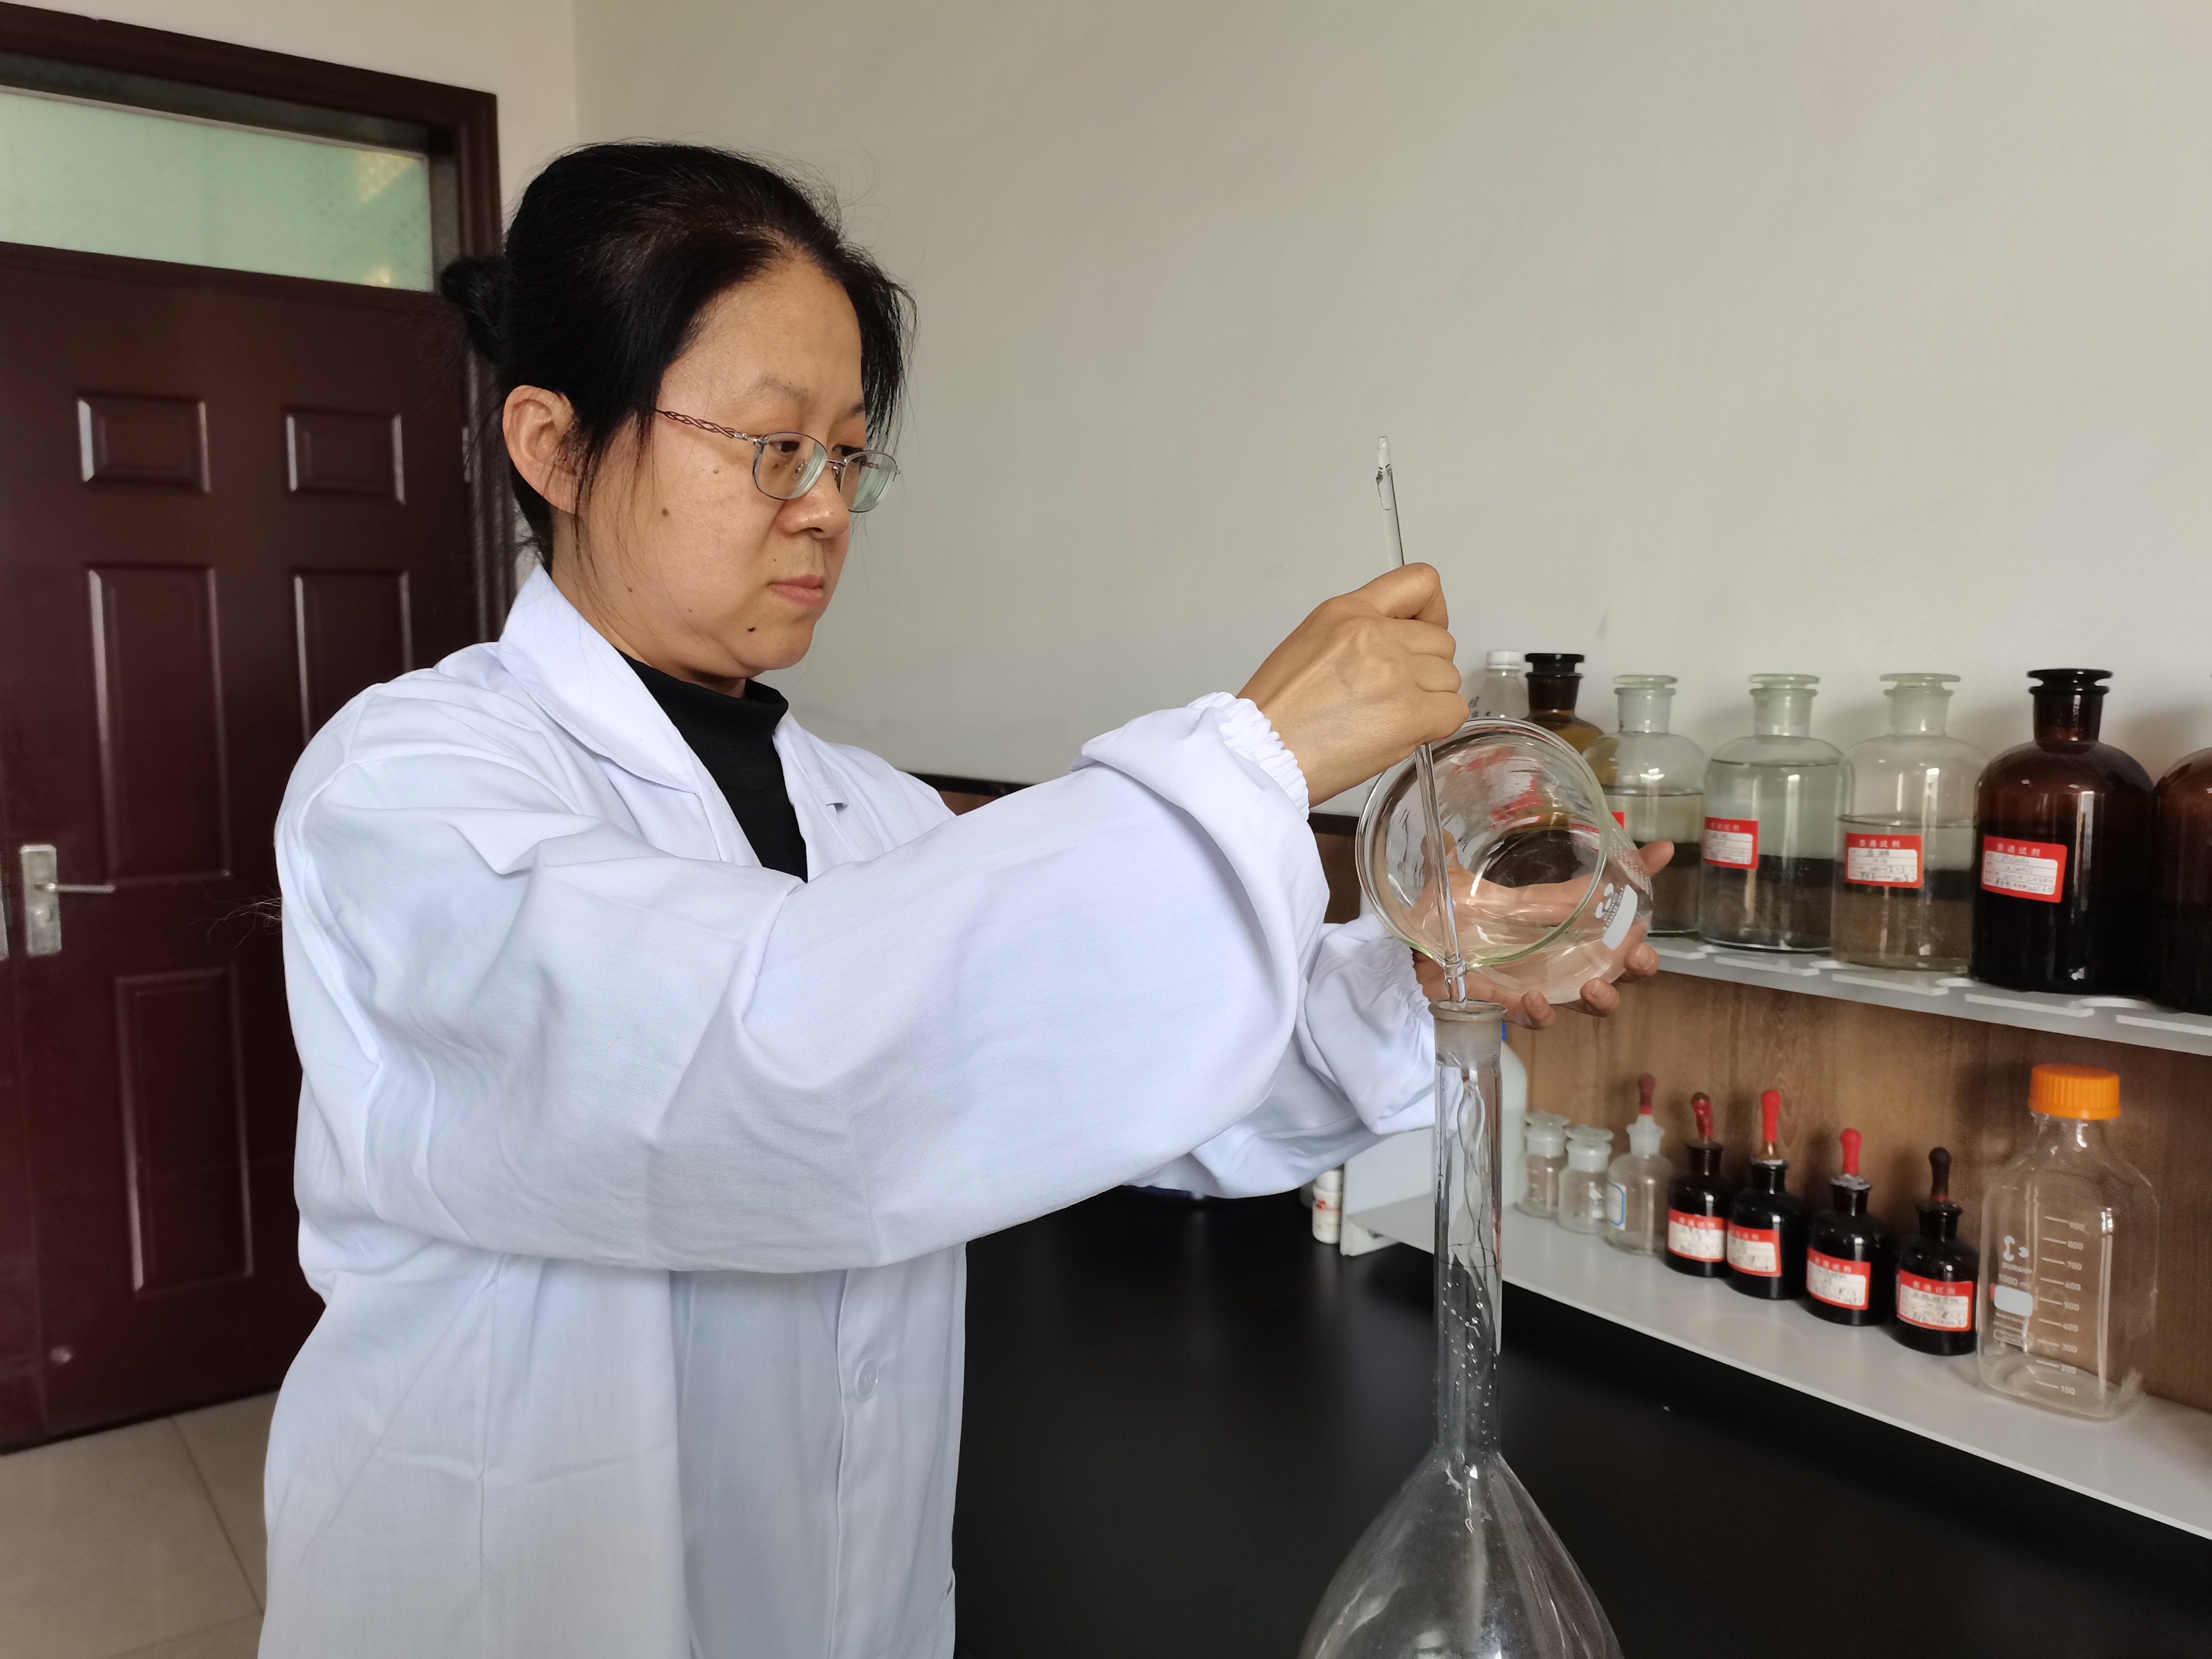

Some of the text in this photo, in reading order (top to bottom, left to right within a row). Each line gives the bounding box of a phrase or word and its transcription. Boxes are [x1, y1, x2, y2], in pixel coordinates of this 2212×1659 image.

[1997, 843, 2040, 856] 普通试剂
[2066, 1261, 2082, 1271] 700
[1998, 1274, 2018, 1286] 1000
[2065, 1282, 2081, 1291] 600
[2063, 1322, 2079, 1333] 400
[2062, 1343, 2078, 1353] 300
[2061, 1364, 2076, 1374] 200
[2061, 1385, 2075, 1395] 100
